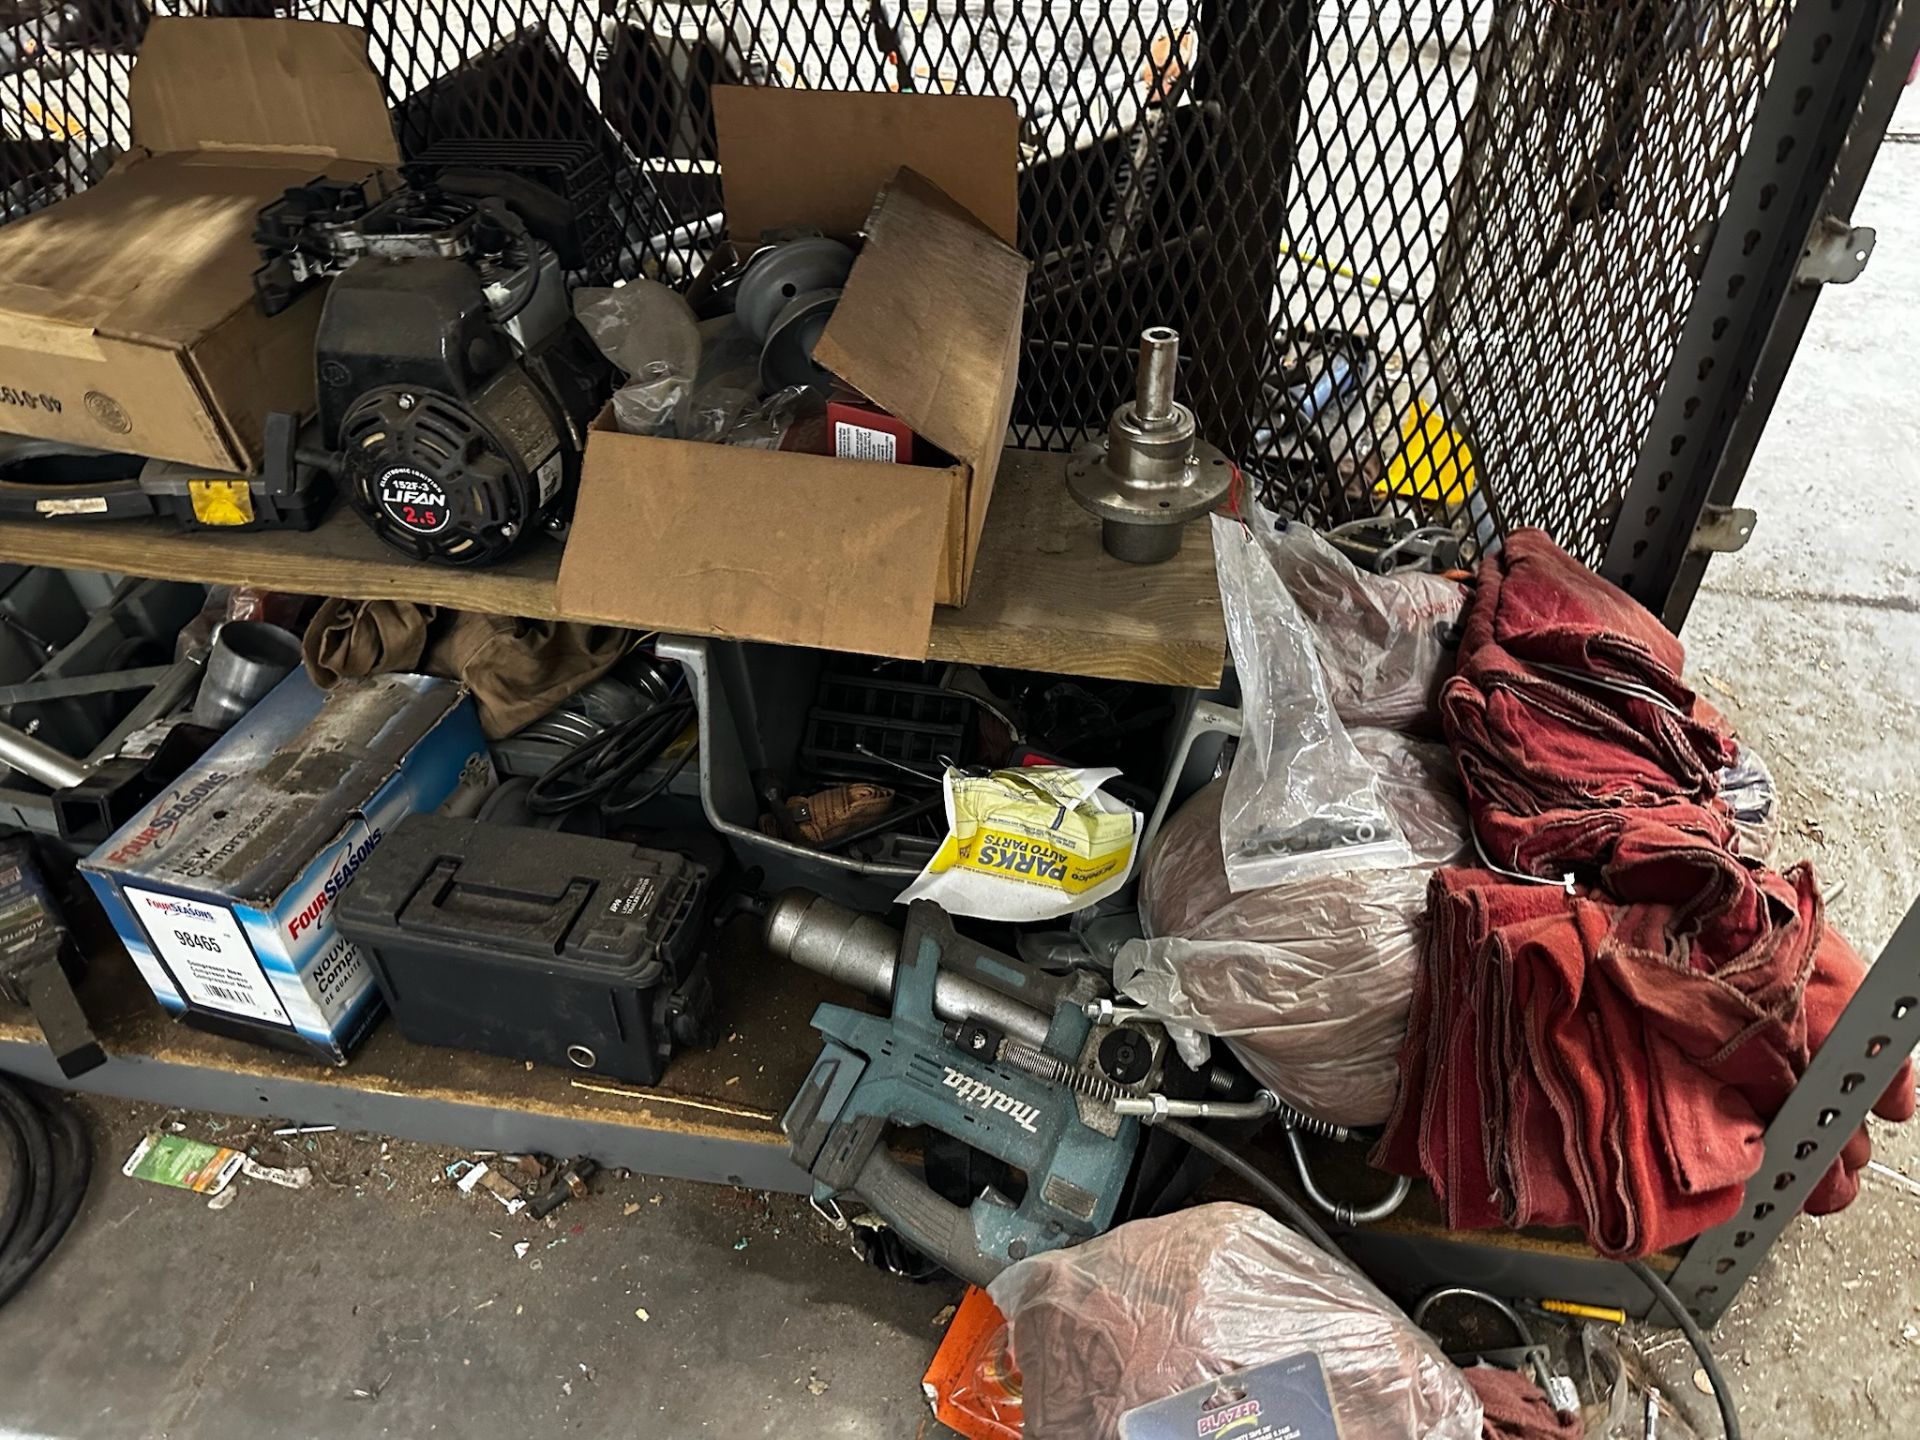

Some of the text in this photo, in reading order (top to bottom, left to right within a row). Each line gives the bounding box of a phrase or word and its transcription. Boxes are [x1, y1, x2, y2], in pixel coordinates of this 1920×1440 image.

[392, 479, 430, 492] 152F-3
[411, 470, 443, 493] IGNITION
[382, 488, 446, 507] LIFAN
[402, 506, 437, 526] 2.5
[186, 803, 277, 878] Compressor
[984, 834, 1028, 853] PARTS
[172, 846, 212, 876] NEW
[978, 845, 1069, 882] PARKS
[1030, 845, 1068, 863] AUTO
[287, 827, 384, 940] FOURSEASONS
[0, 919, 44, 942] ADAPTE
[173, 930, 222, 953] 98465
[187, 959, 243, 977] Compressor New
[324, 990, 335, 1006] DE
[942, 1066, 1041, 1133] makita
[1197, 1400, 1263, 1437] BLAZER
